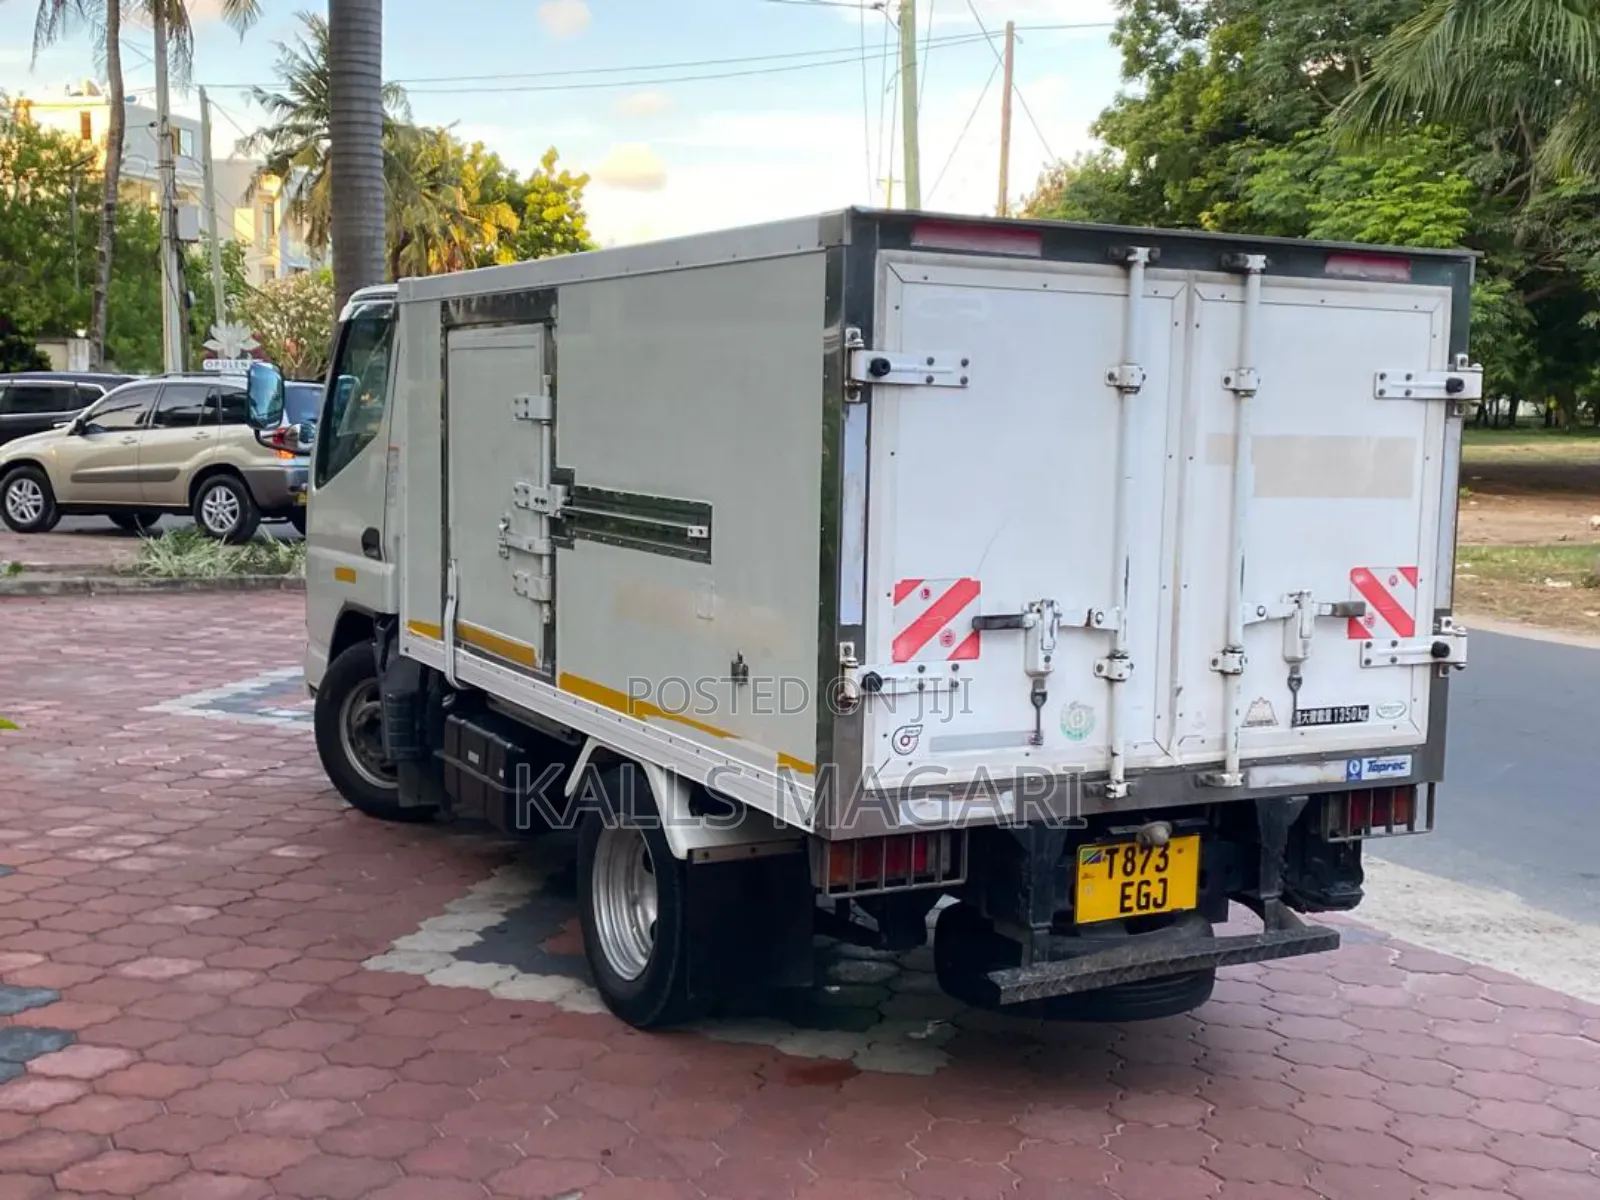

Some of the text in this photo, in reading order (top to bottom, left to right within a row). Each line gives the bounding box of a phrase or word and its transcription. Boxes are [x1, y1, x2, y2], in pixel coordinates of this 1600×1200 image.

[205, 361, 249, 369] OPULEN
[1105, 841, 1170, 879] T873
[1120, 878, 1168, 913] EGJ
